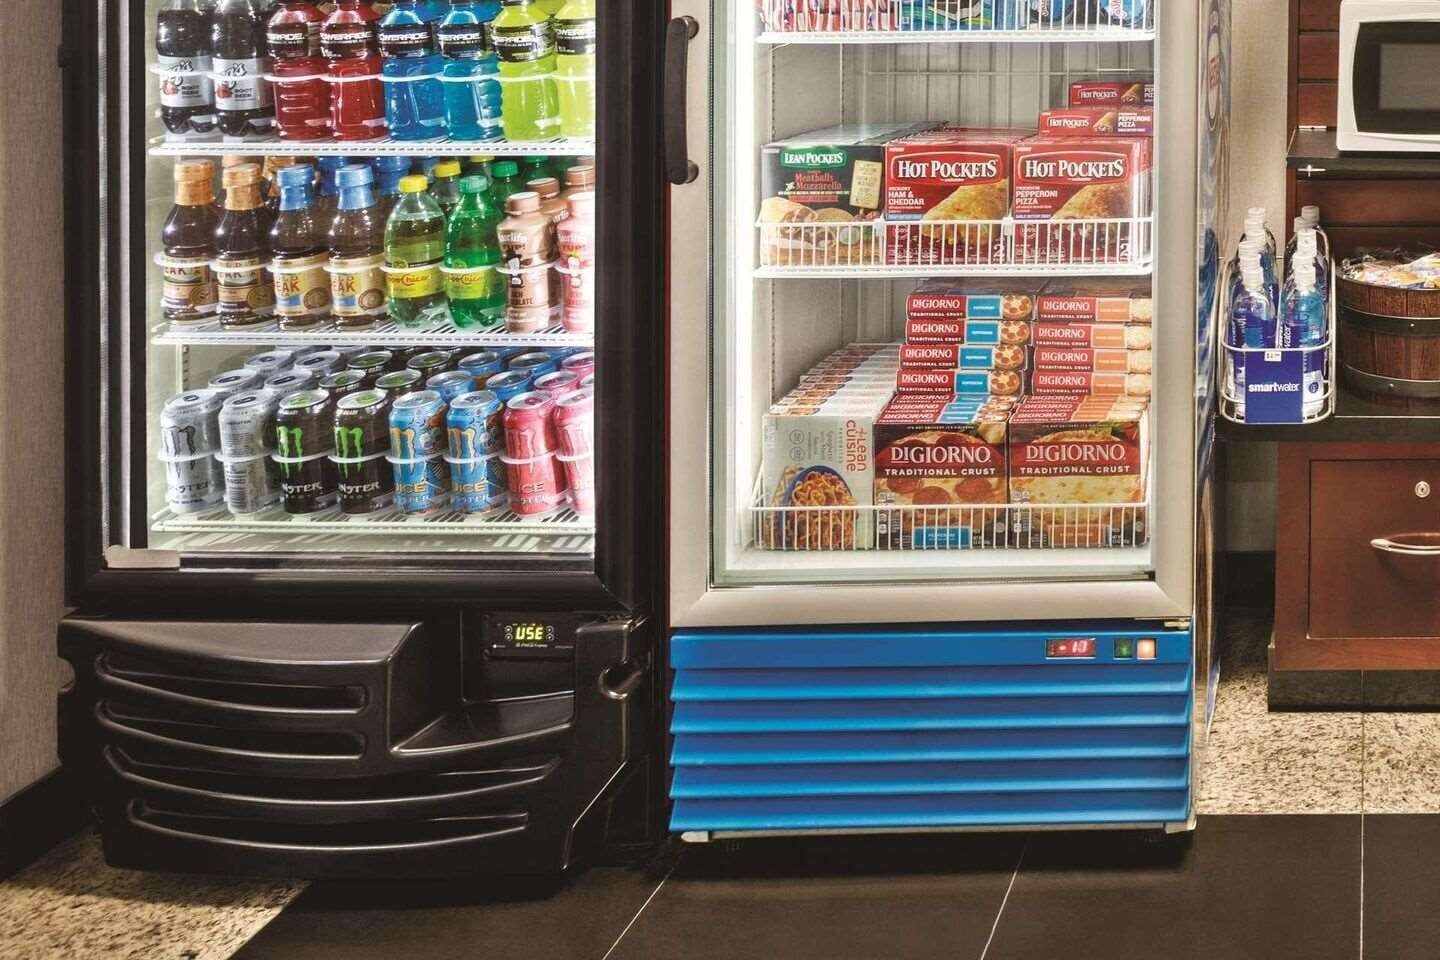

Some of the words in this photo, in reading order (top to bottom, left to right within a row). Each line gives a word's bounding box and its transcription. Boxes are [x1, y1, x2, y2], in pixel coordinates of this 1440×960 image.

[1049, 119, 1062, 127] HOT
[1062, 119, 1089, 127] POCKETS
[784, 152, 807, 164] LEAN
[807, 151, 844, 164] POCKETS
[898, 161, 928, 178] HOT
[931, 159, 997, 178] POCKETS
[1025, 161, 1056, 178] HOT
[1058, 159, 1124, 179] POCKETS
[1015, 190, 1058, 198] PEPPERONI
[888, 198, 925, 206] CHEDDAR
[912, 299, 960, 309] DIGIORNO
[1043, 300, 1090, 310] DIGIORNO
[911, 323, 959, 333] DIGIORNO
[1038, 328, 1085, 338] DIGIORNO
[905, 348, 952, 358] DIGIORNO
[1041, 352, 1088, 362] DIGIORNO
[901, 374, 949, 384] DIGIORNO
[1039, 376, 1085, 385] DIGIORNO
[1248, 382, 1300, 393] smartwater
[846, 419, 856, 472] cuisine
[856, 438, 867, 472] Lean
[891, 446, 991, 464] DIGIORNO
[1025, 444, 1126, 462] DIGIORNO
[884, 467, 957, 476] TRADITIONAL
[961, 467, 996, 476] CRUST
[1020, 466, 1092, 475] TRADITIONAL
[1095, 465, 1131, 474] CRUST
[515, 626, 543, 640] USE
